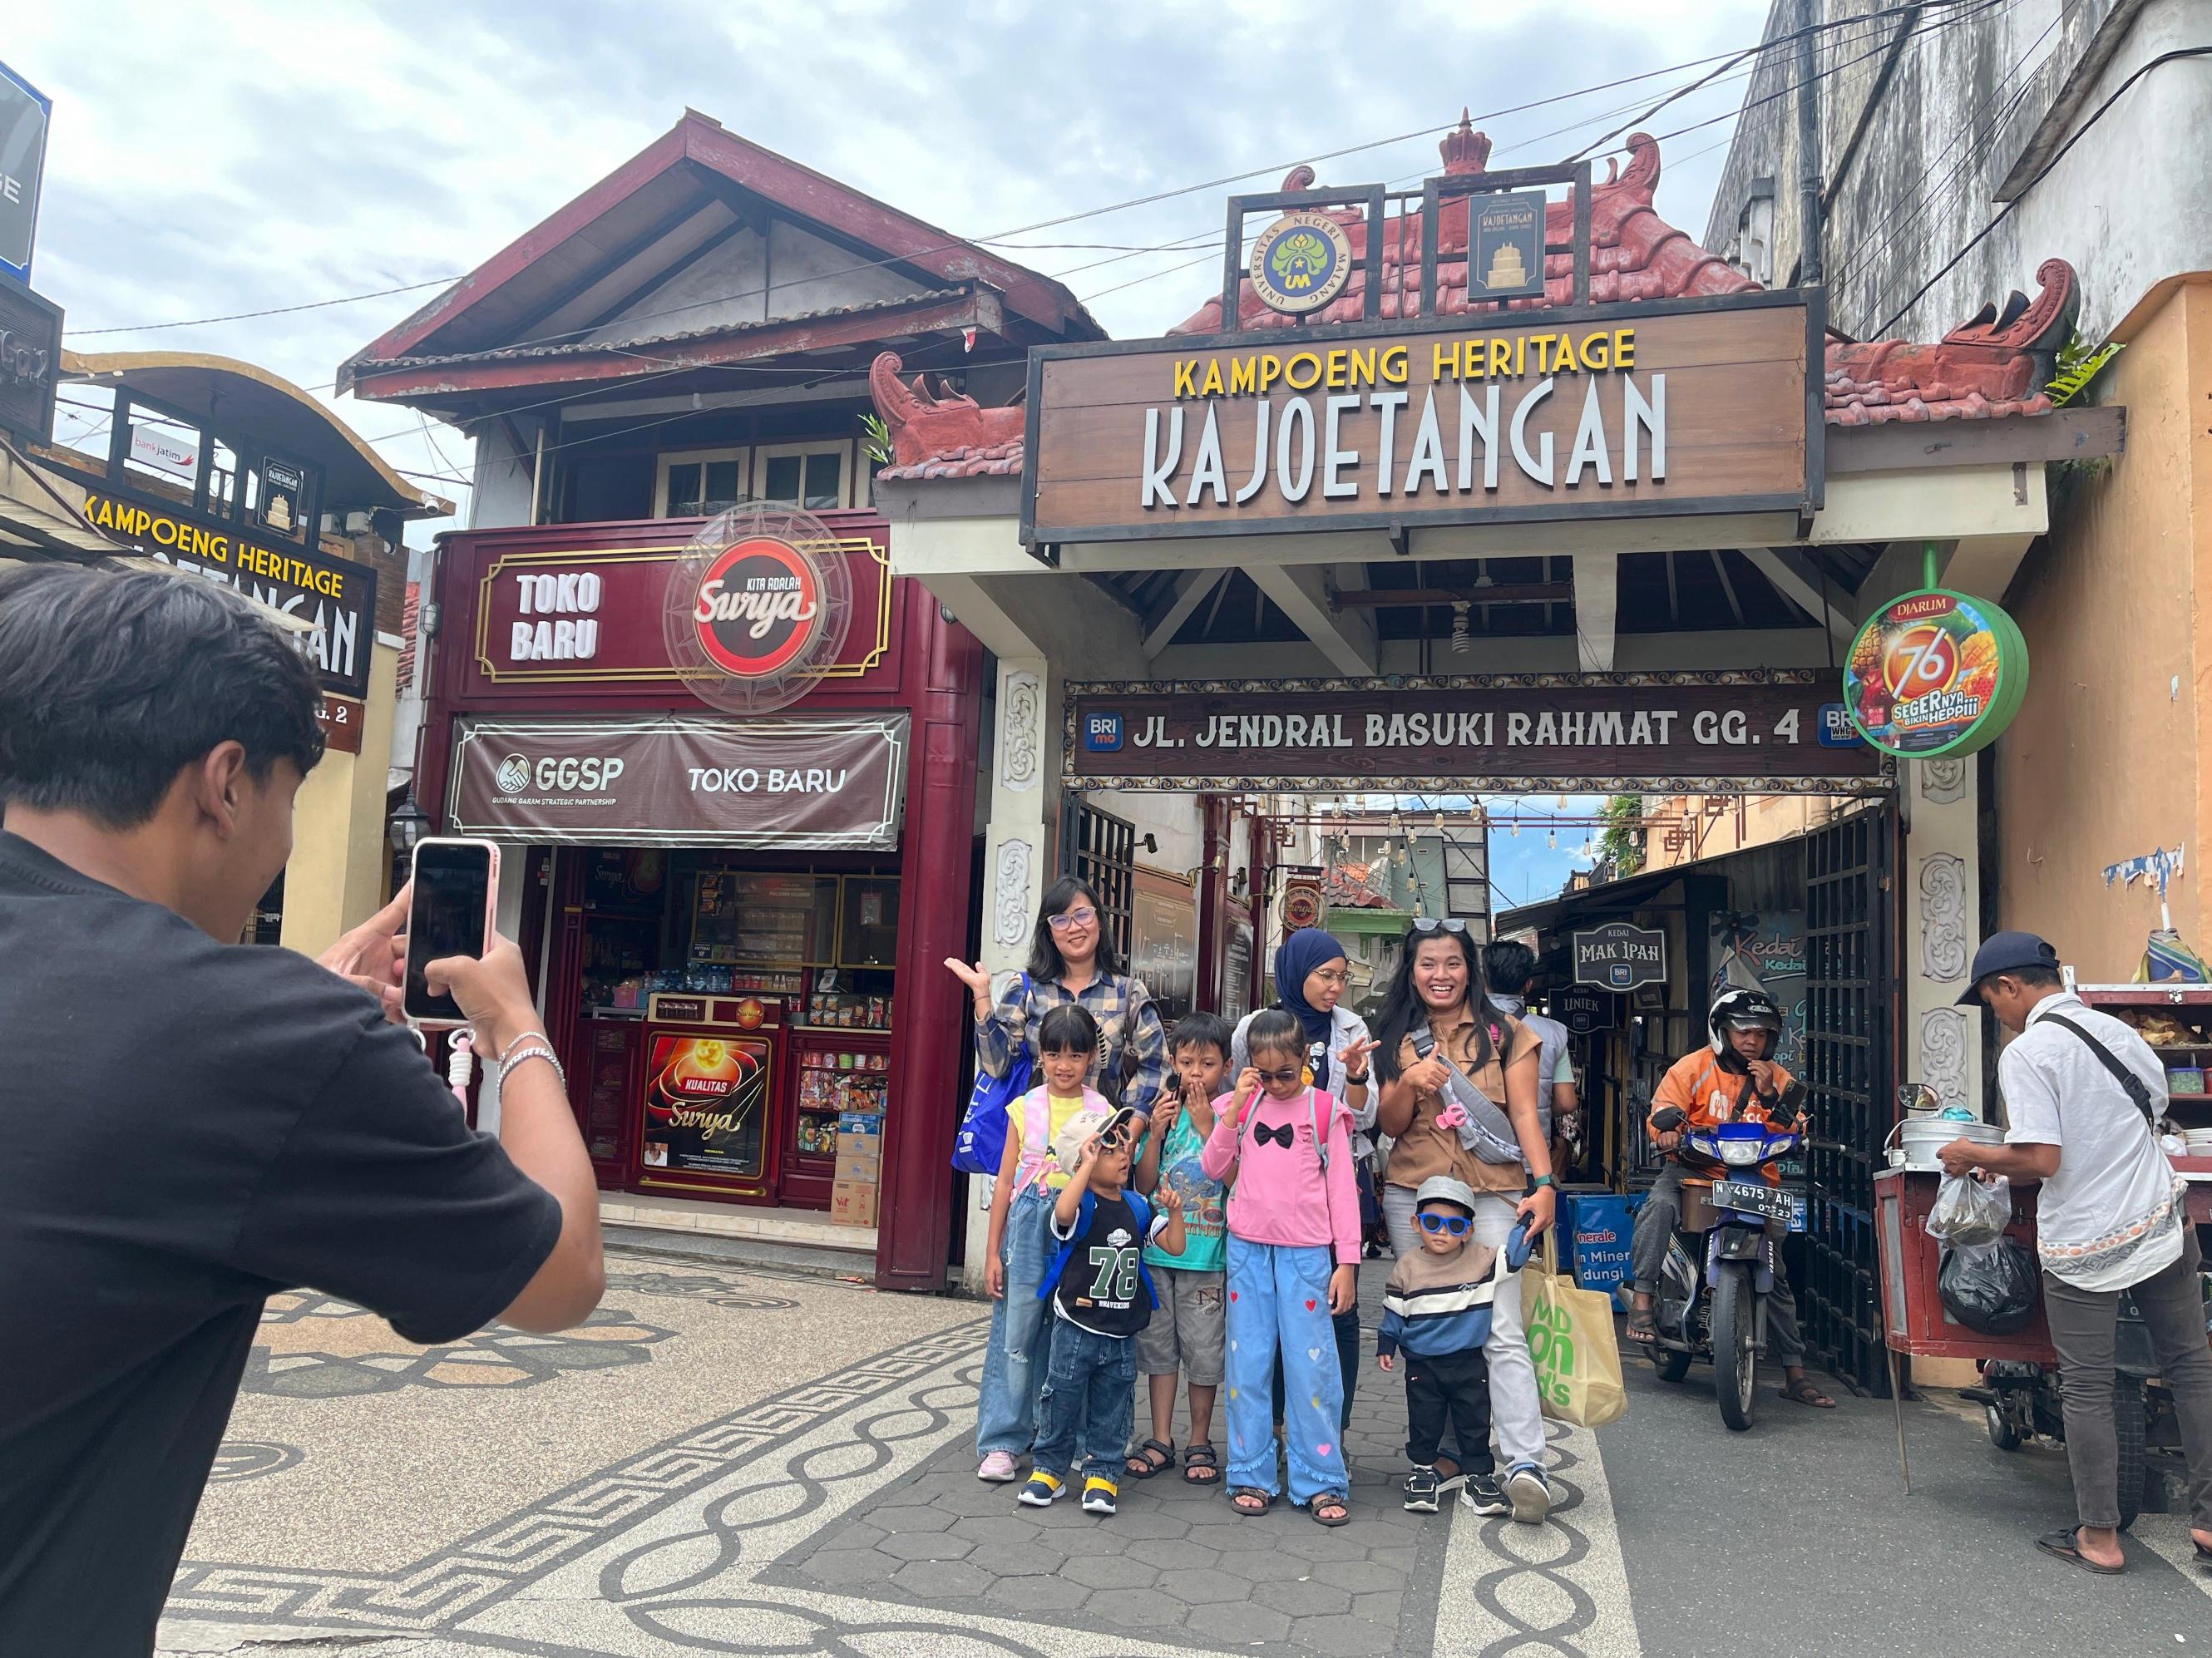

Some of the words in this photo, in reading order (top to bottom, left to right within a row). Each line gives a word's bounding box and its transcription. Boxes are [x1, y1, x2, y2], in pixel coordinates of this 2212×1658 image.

[1294, 216, 1340, 239] NEGERI
[1254, 227, 1285, 305] UNIVERSITAS
[1285, 274, 1311, 289] UM
[1310, 254, 1346, 303] MALANG
[1174, 345, 1408, 397] KAMPOENG
[1433, 328, 1636, 383] HERITAGE
[135, 437, 180, 461] bankjatim
[1140, 373, 1666, 507] KAJOETANGAN
[84, 496, 228, 563] KAMPOENG
[237, 543, 343, 599] HERITAGE
[516, 572, 601, 614] TOKO
[747, 578, 766, 591] KITA
[768, 577, 802, 590] ADALAH
[694, 580, 817, 639] Surya
[1897, 598, 1947, 616] DJARUM
[510, 619, 599, 661] BARU
[1892, 627, 1947, 700] 76
[335, 705, 348, 724] 2
[1090, 718, 1116, 734] BRI
[1826, 711, 1855, 728] BR
[1904, 714, 1928, 726] BIKIN
[1094, 734, 1116, 744] mo
[1133, 716, 1185, 748] JL.
[1195, 714, 1353, 748] JENDRAL
[1365, 712, 1494, 748] BASUKI
[1506, 710, 1677, 746] RAHMAT
[1692, 709, 1760, 745] GG.
[1774, 708, 1800, 745] 4
[535, 757, 625, 792] GGSP
[688, 767, 759, 793] TOKO
[767, 768, 846, 793] BARU
[1607, 929, 1630, 937] KEDAI
[1580, 942, 1617, 963] MAK
[1622, 940, 1660, 961] IPAH
[1614, 968, 1627, 976] BRI
[1563, 998, 1600, 1012] UNIEK
[684, 1078, 728, 1093] KUALITAS
[667, 1101, 742, 1141] Surya
[1716, 1182, 1723, 1194] N
[1733, 1185, 1765, 1200] 4675
[1775, 1192, 1791, 1207] AH
[1591, 1251, 1630, 1263] Miner
[1089, 1246, 1140, 1300] 78
[1582, 1267, 1624, 1281] dungi
